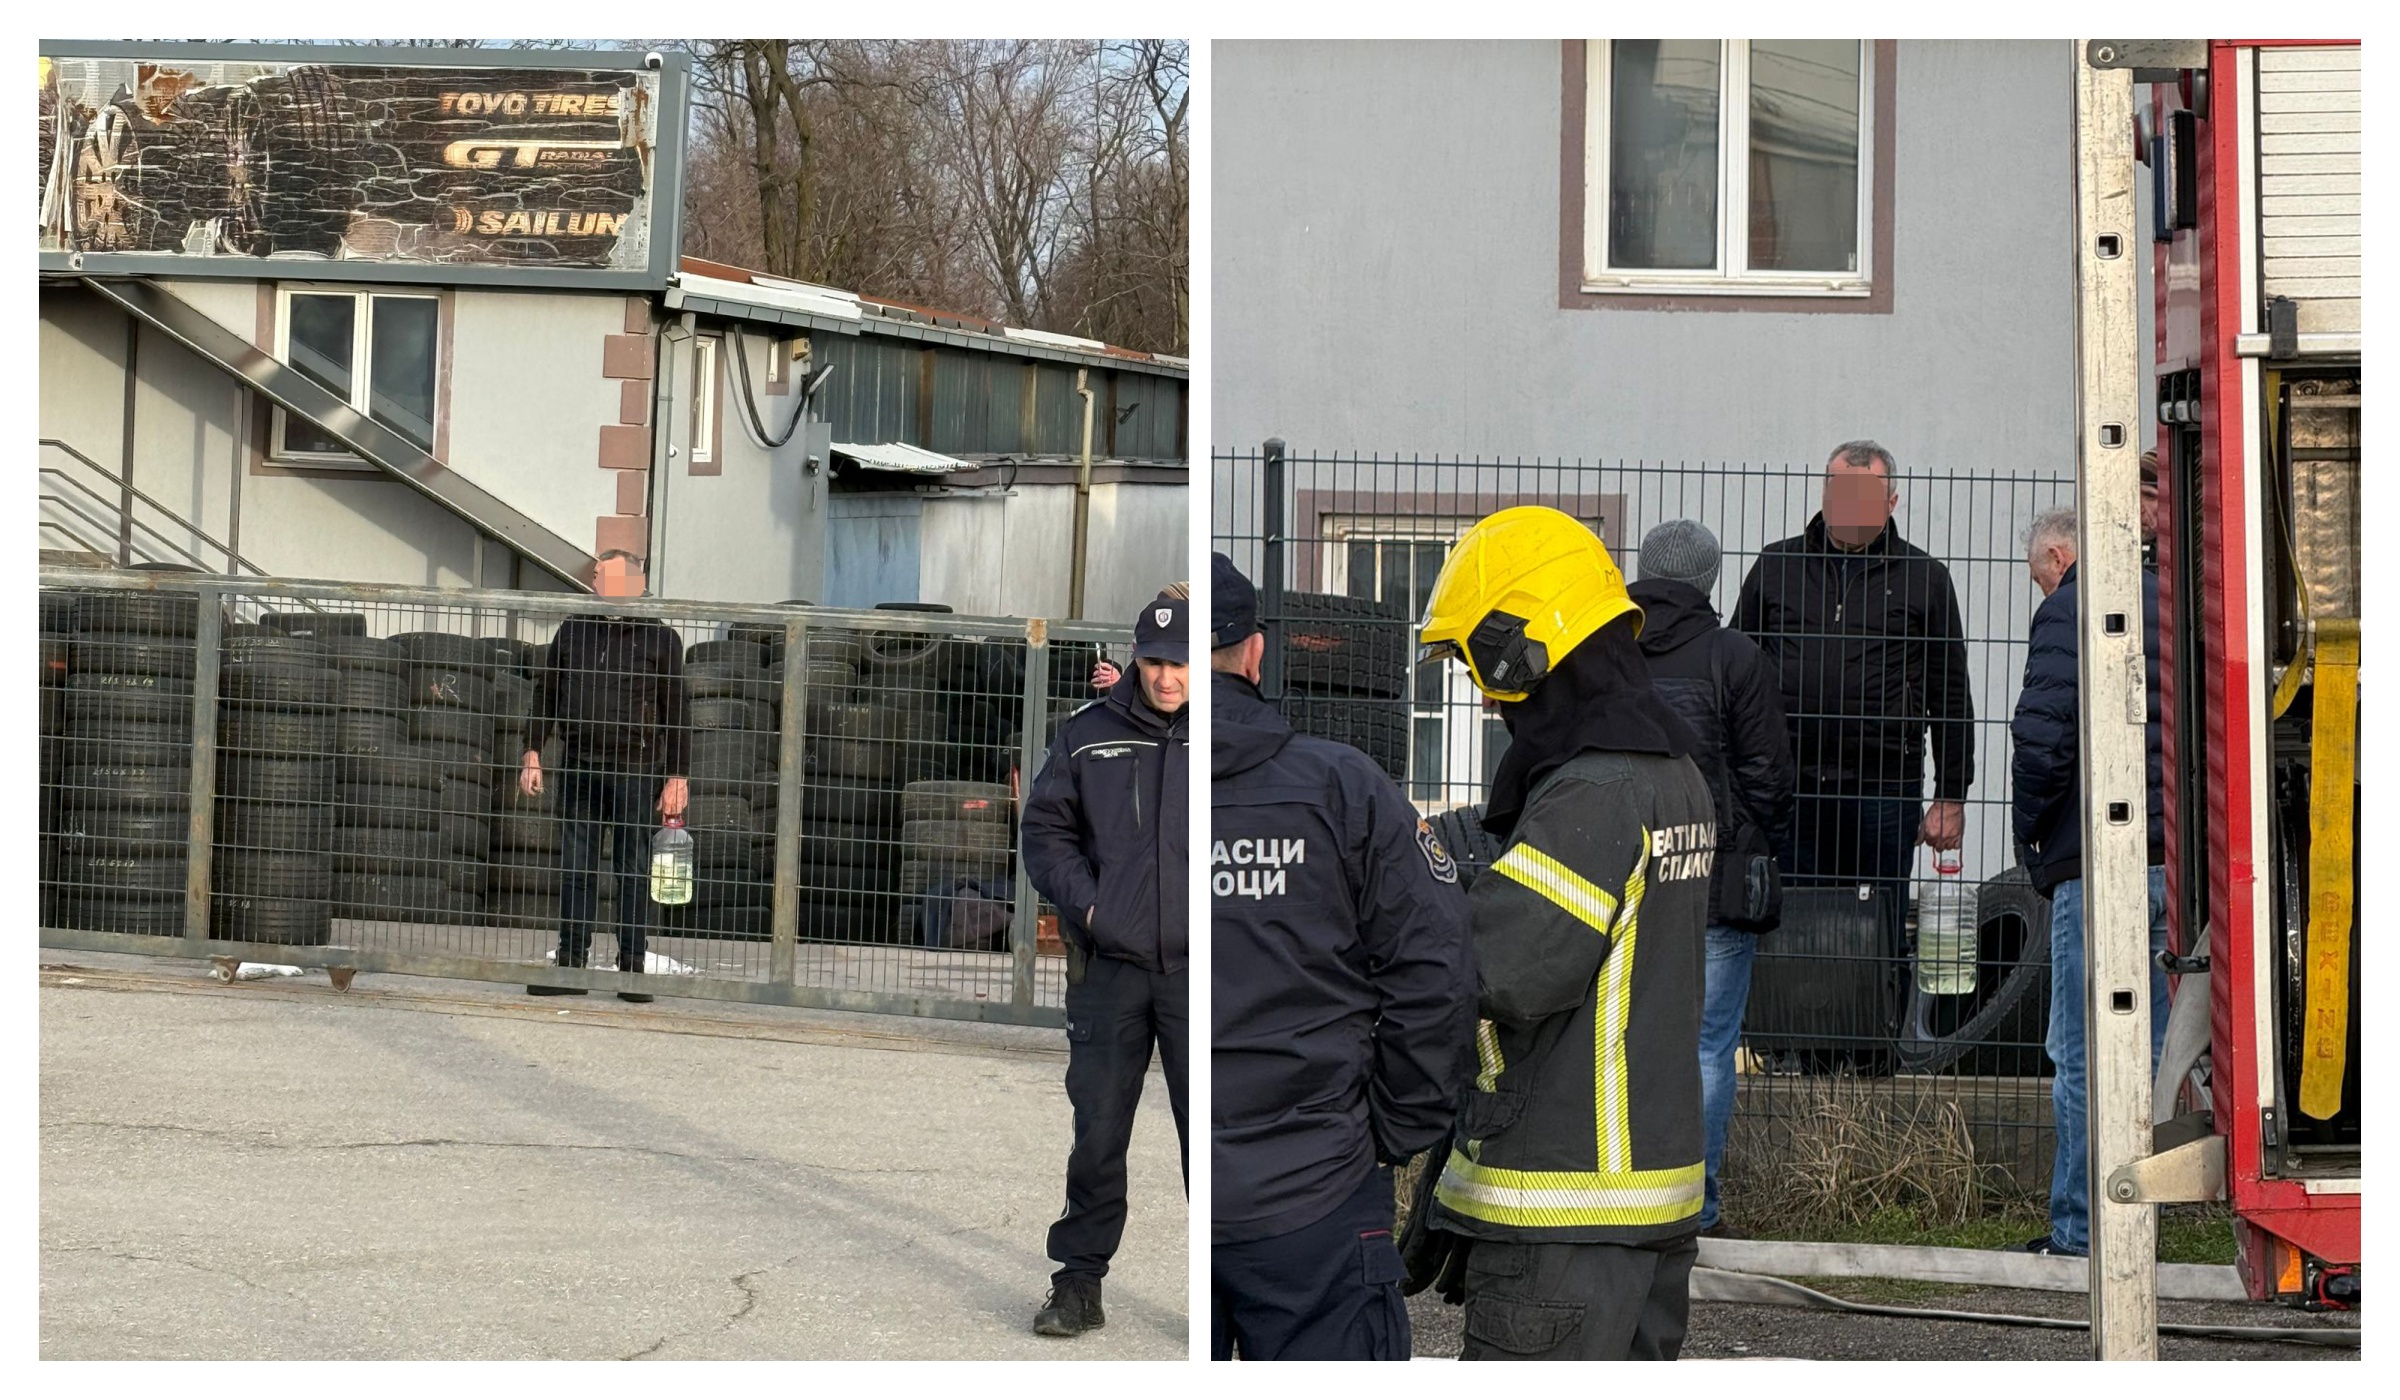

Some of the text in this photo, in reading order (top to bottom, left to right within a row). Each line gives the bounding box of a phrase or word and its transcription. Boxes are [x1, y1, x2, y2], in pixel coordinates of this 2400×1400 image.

[439, 92, 620, 116] TOYO TIRES
[443, 139, 621, 168] GT
[476, 210, 629, 236] SAILUN
[1211, 838, 1305, 869] АСЦИ
[1212, 870, 1287, 900] ОЦИ
